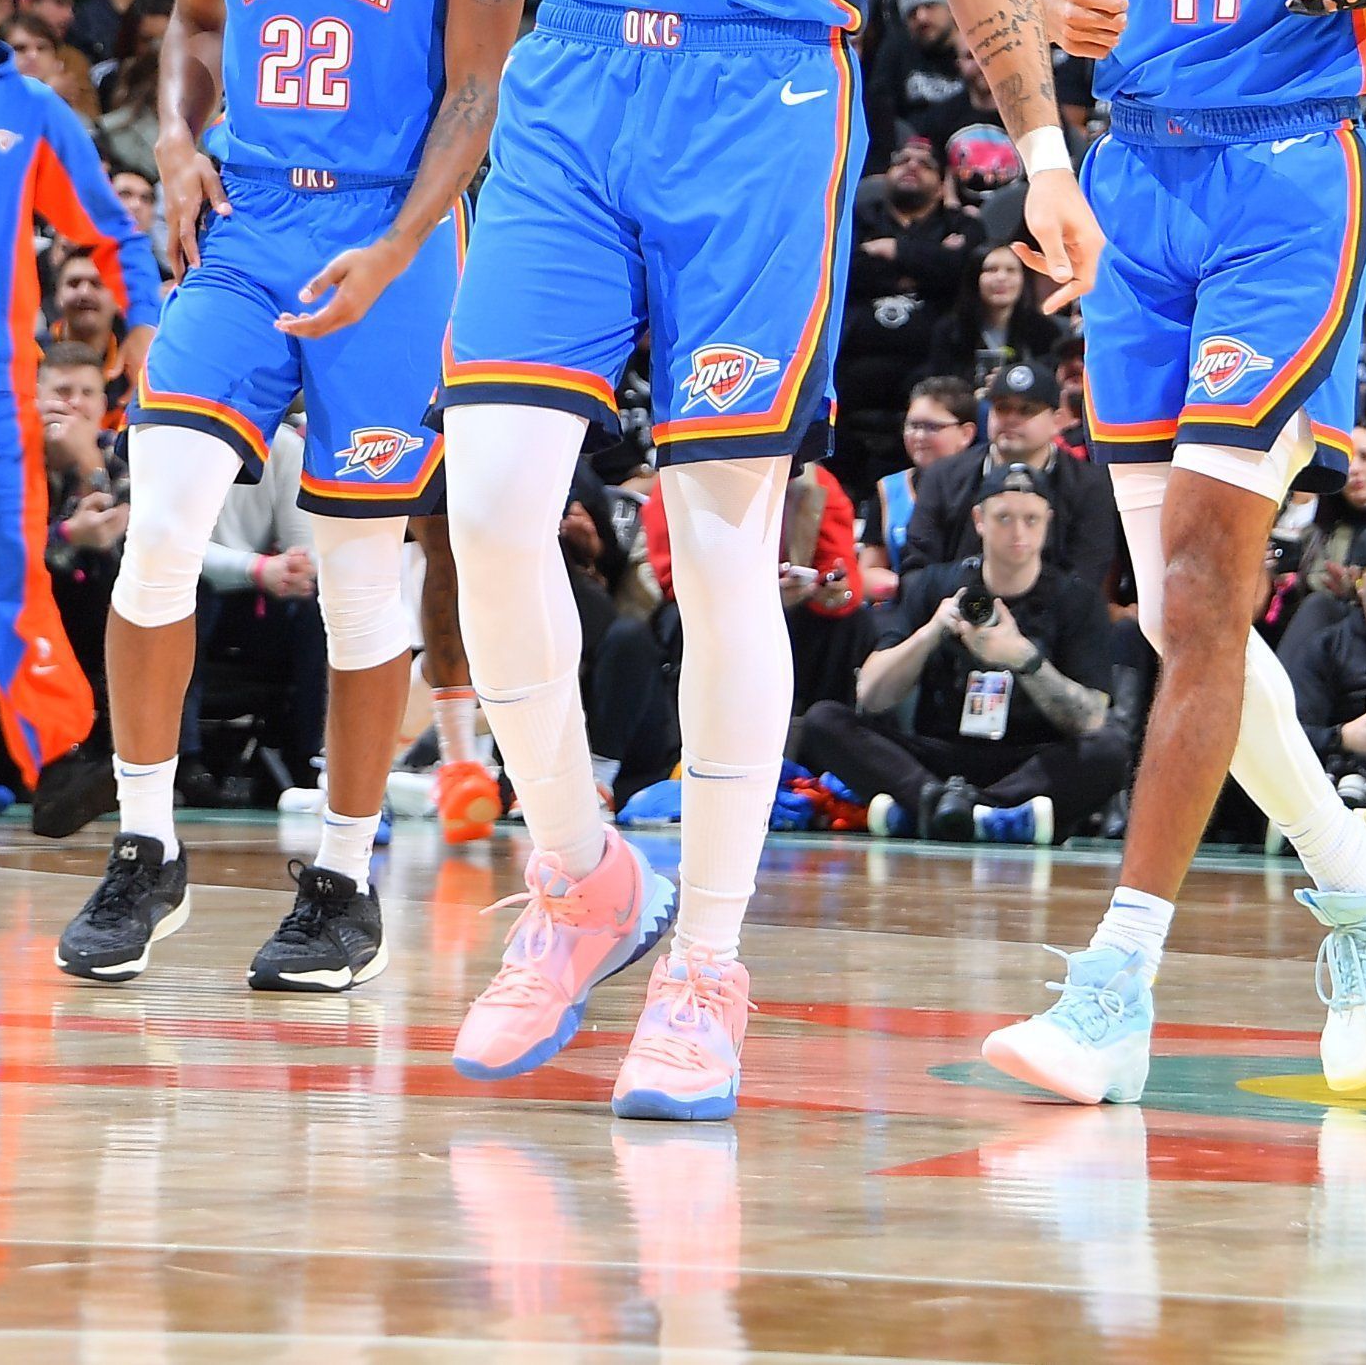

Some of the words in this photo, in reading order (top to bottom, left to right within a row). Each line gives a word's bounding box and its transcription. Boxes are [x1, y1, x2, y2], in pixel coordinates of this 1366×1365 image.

[623, 9, 681, 48] OKC
[256, 15, 351, 111] 22
[290, 167, 335, 188] OKC
[689, 356, 747, 396] OKC
[1191, 350, 1239, 378] OKC
[351, 438, 396, 465] OKC
